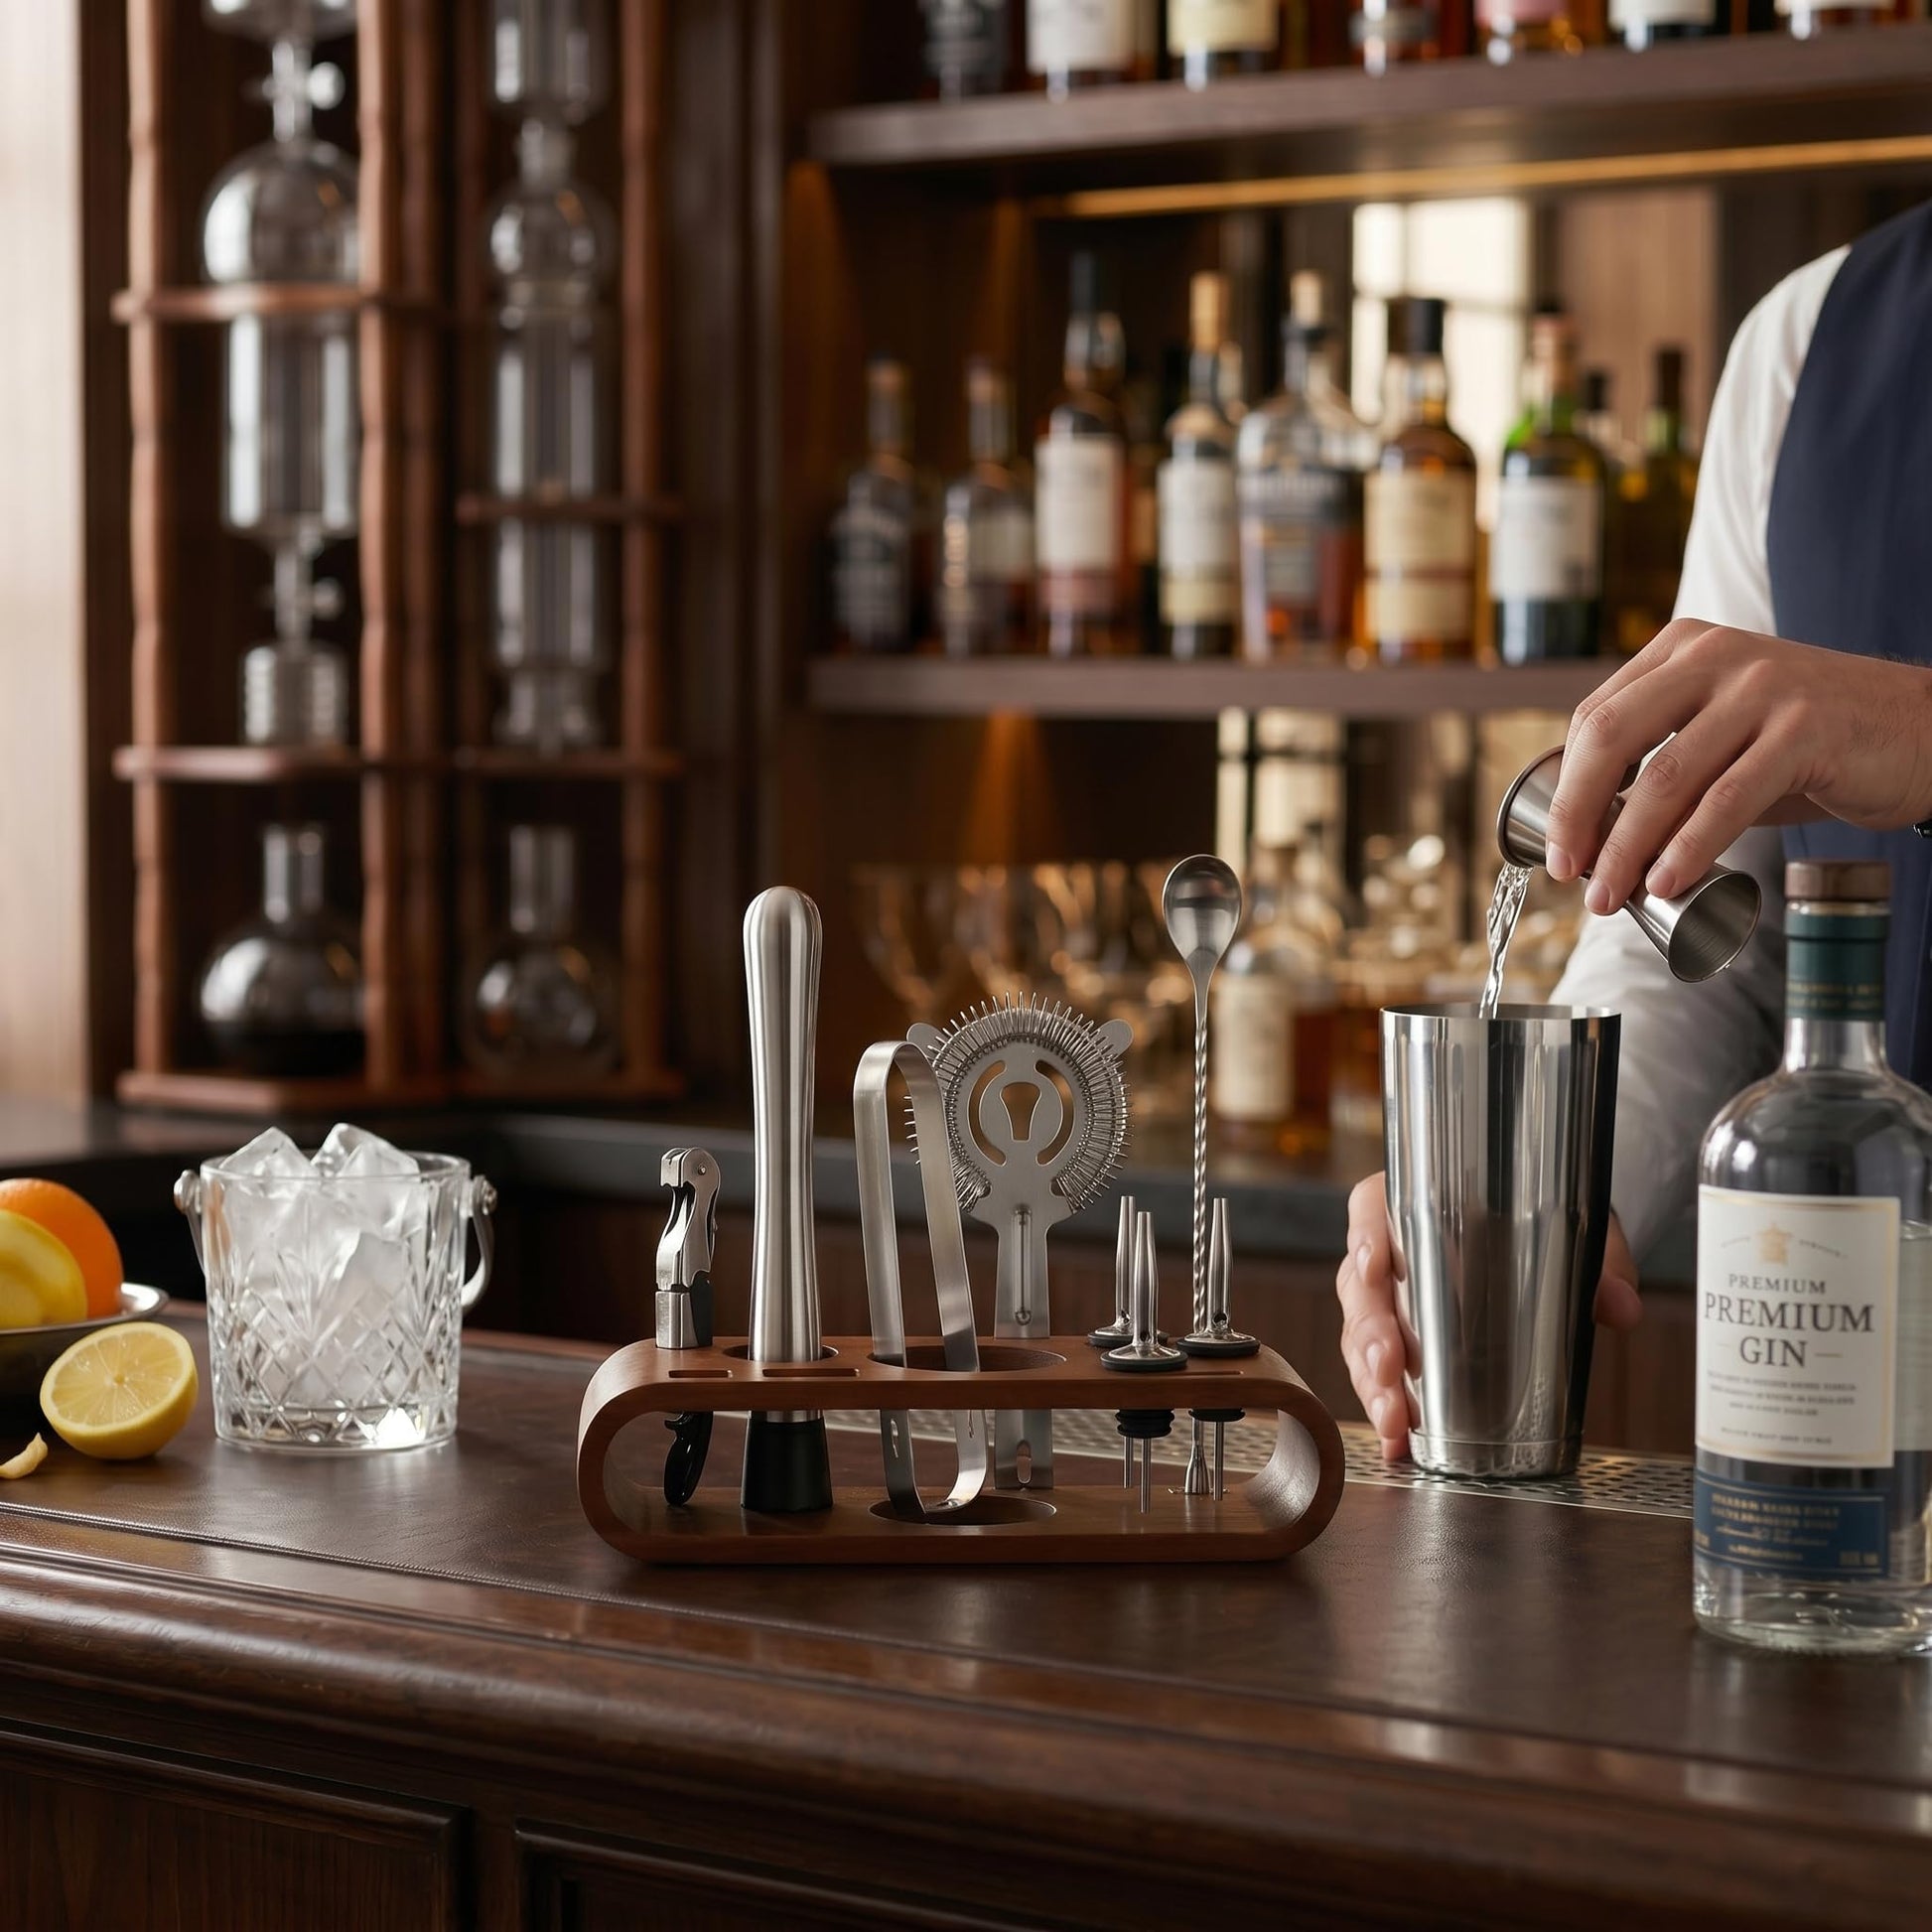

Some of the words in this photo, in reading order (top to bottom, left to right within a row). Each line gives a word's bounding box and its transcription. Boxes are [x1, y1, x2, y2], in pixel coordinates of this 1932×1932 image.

[1728, 1273, 1826, 1294] PREMIUM
[1705, 1292, 1874, 1332] PREMIUM
[1739, 1336, 1808, 1368] GIN
